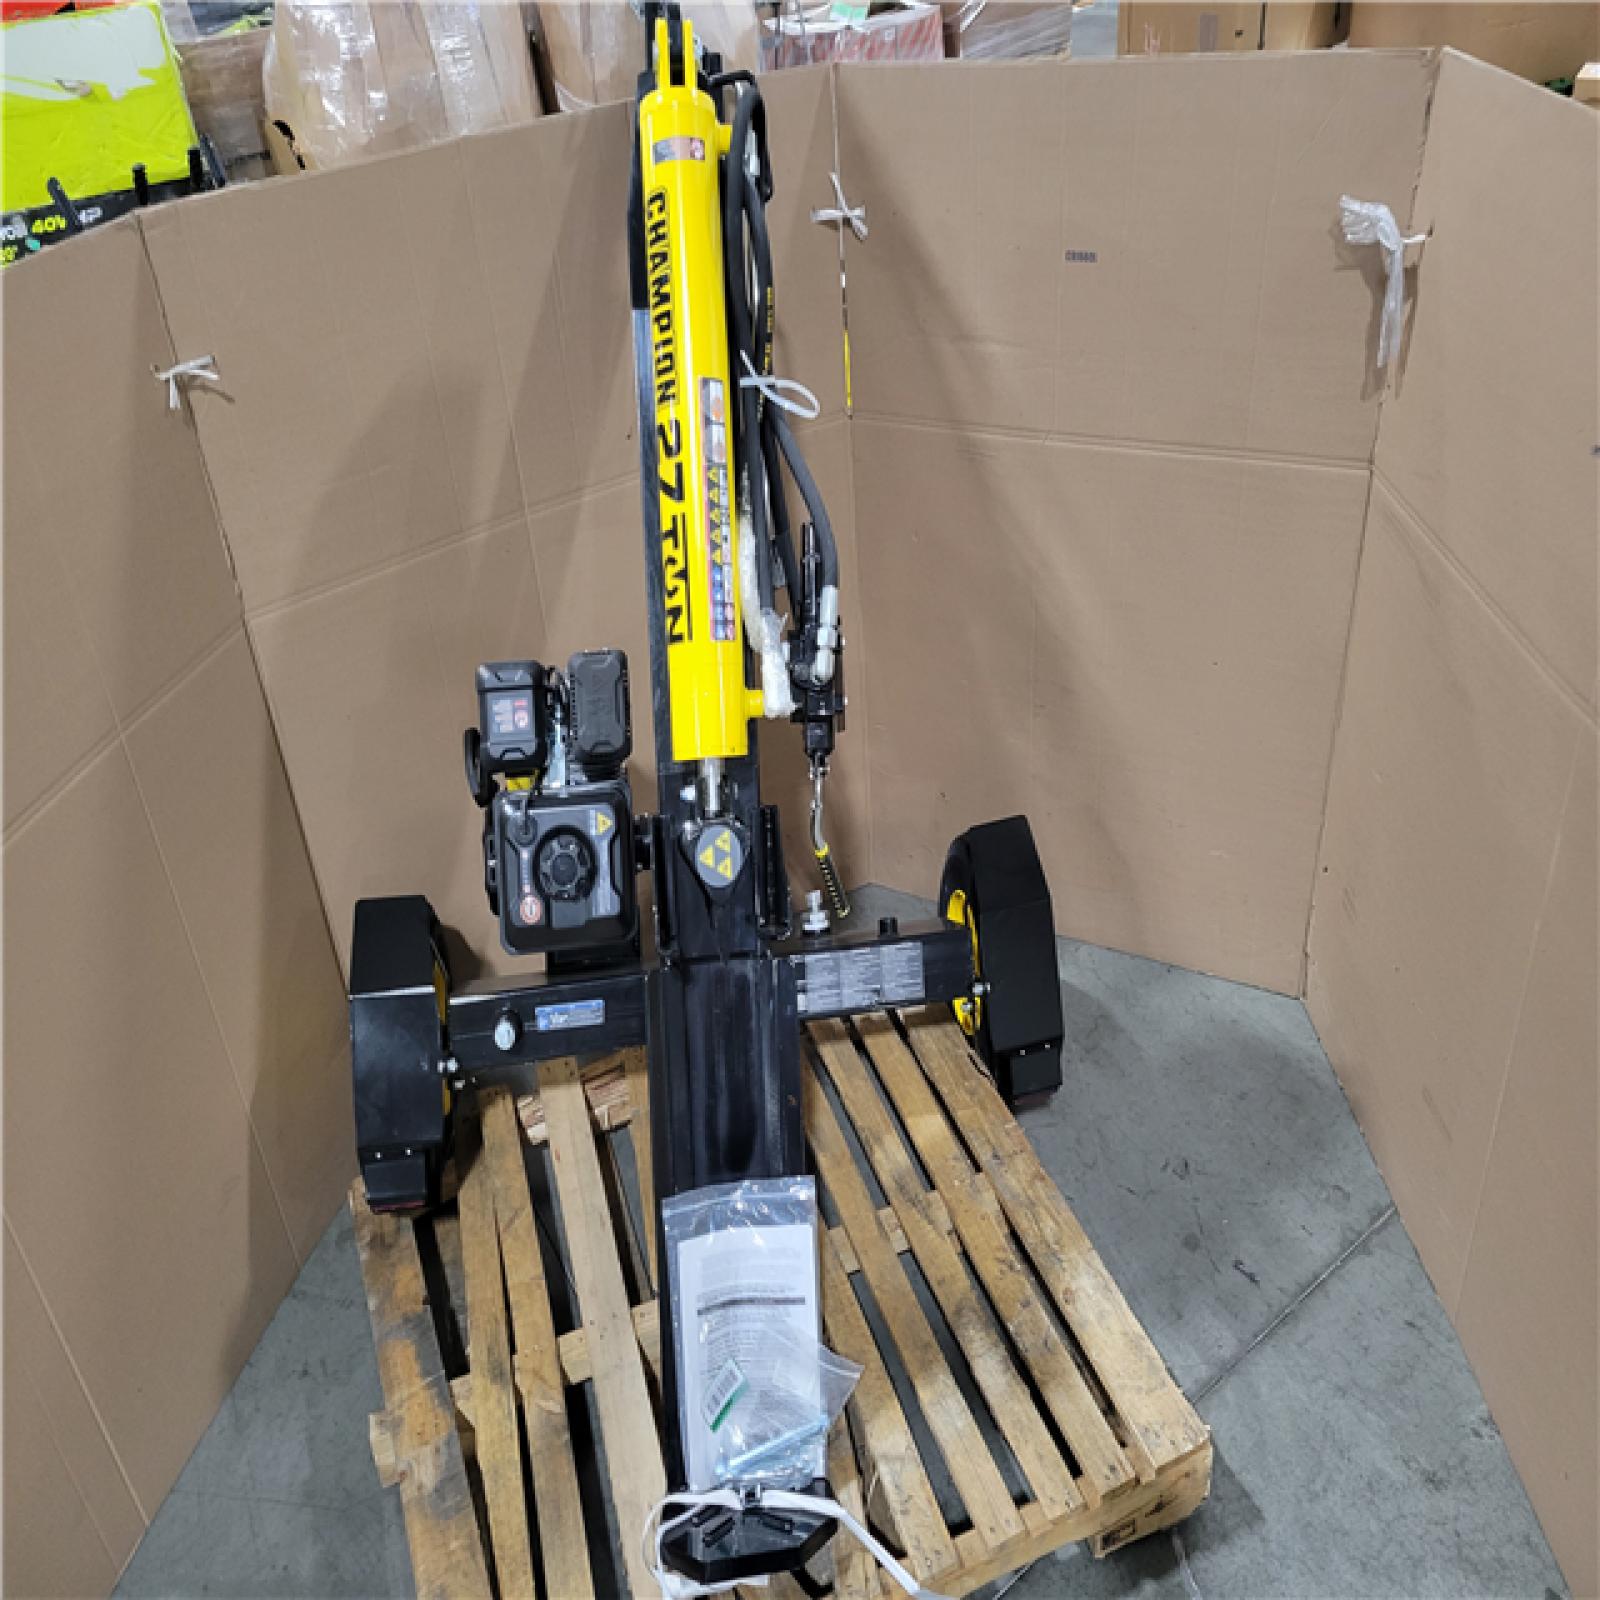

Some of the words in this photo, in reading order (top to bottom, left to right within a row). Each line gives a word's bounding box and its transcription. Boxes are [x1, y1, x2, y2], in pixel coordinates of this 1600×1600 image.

[646, 187, 681, 405] CHAMPION
[656, 419, 686, 502] 27
[662, 514, 690, 645] TON
